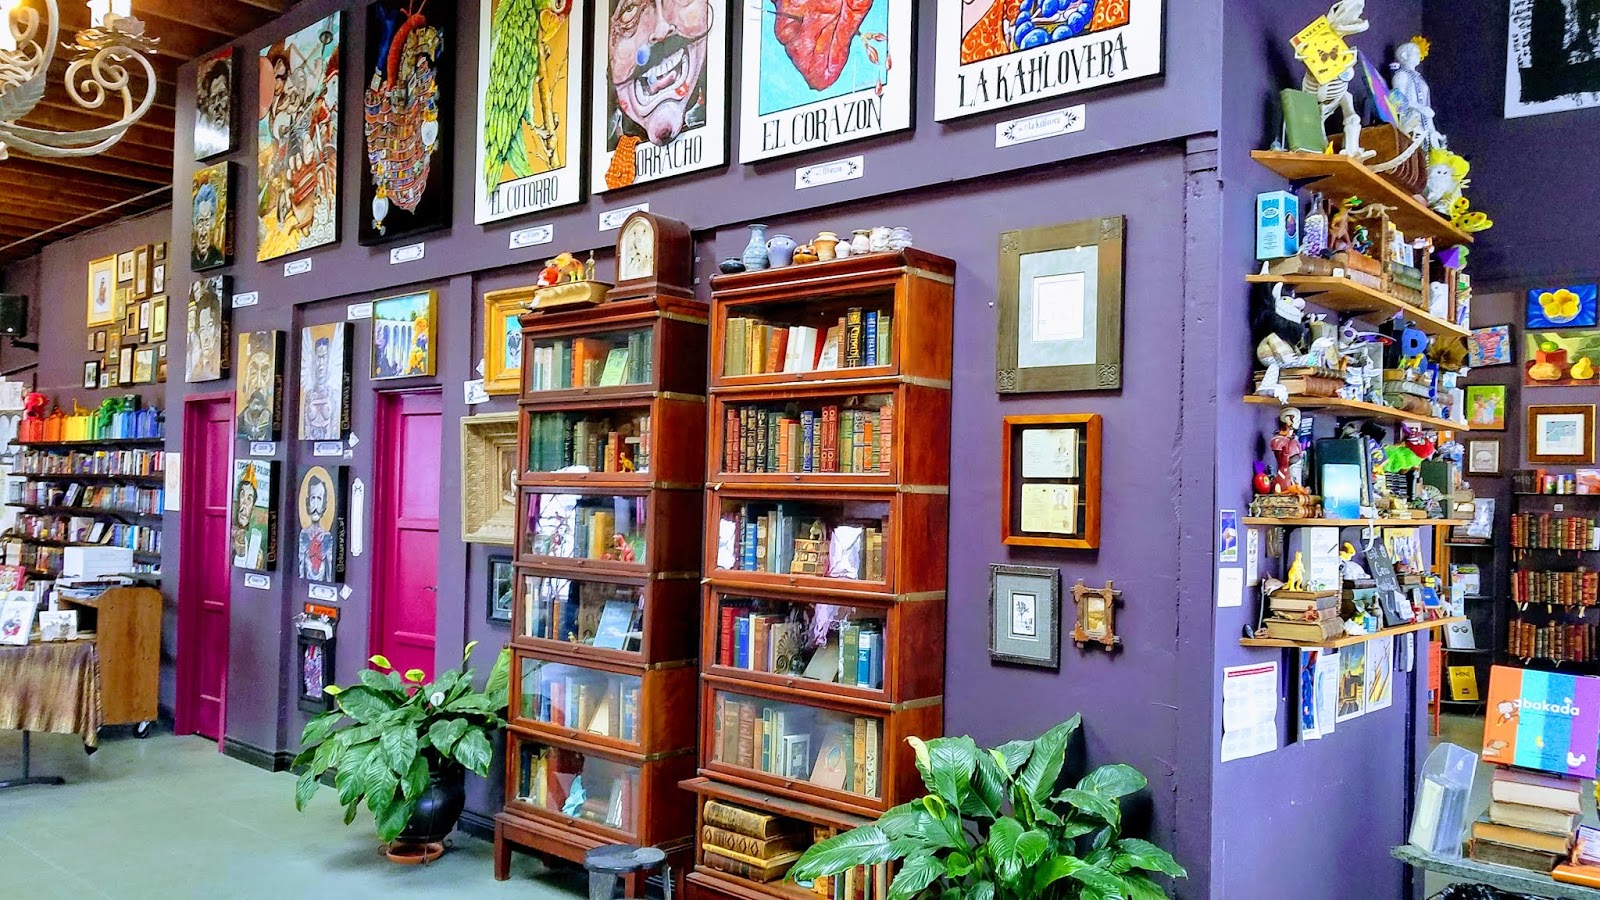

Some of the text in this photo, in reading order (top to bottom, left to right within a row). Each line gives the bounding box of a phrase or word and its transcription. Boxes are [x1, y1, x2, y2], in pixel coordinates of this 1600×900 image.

[958, 31, 1129, 108] LA KAHLOVERA
[762, 93, 885, 152] EL CORAZON
[634, 134, 703, 177] ORRACHO
[490, 175, 559, 216] EL COTORRO
[1513, 698, 1580, 716] abakada
